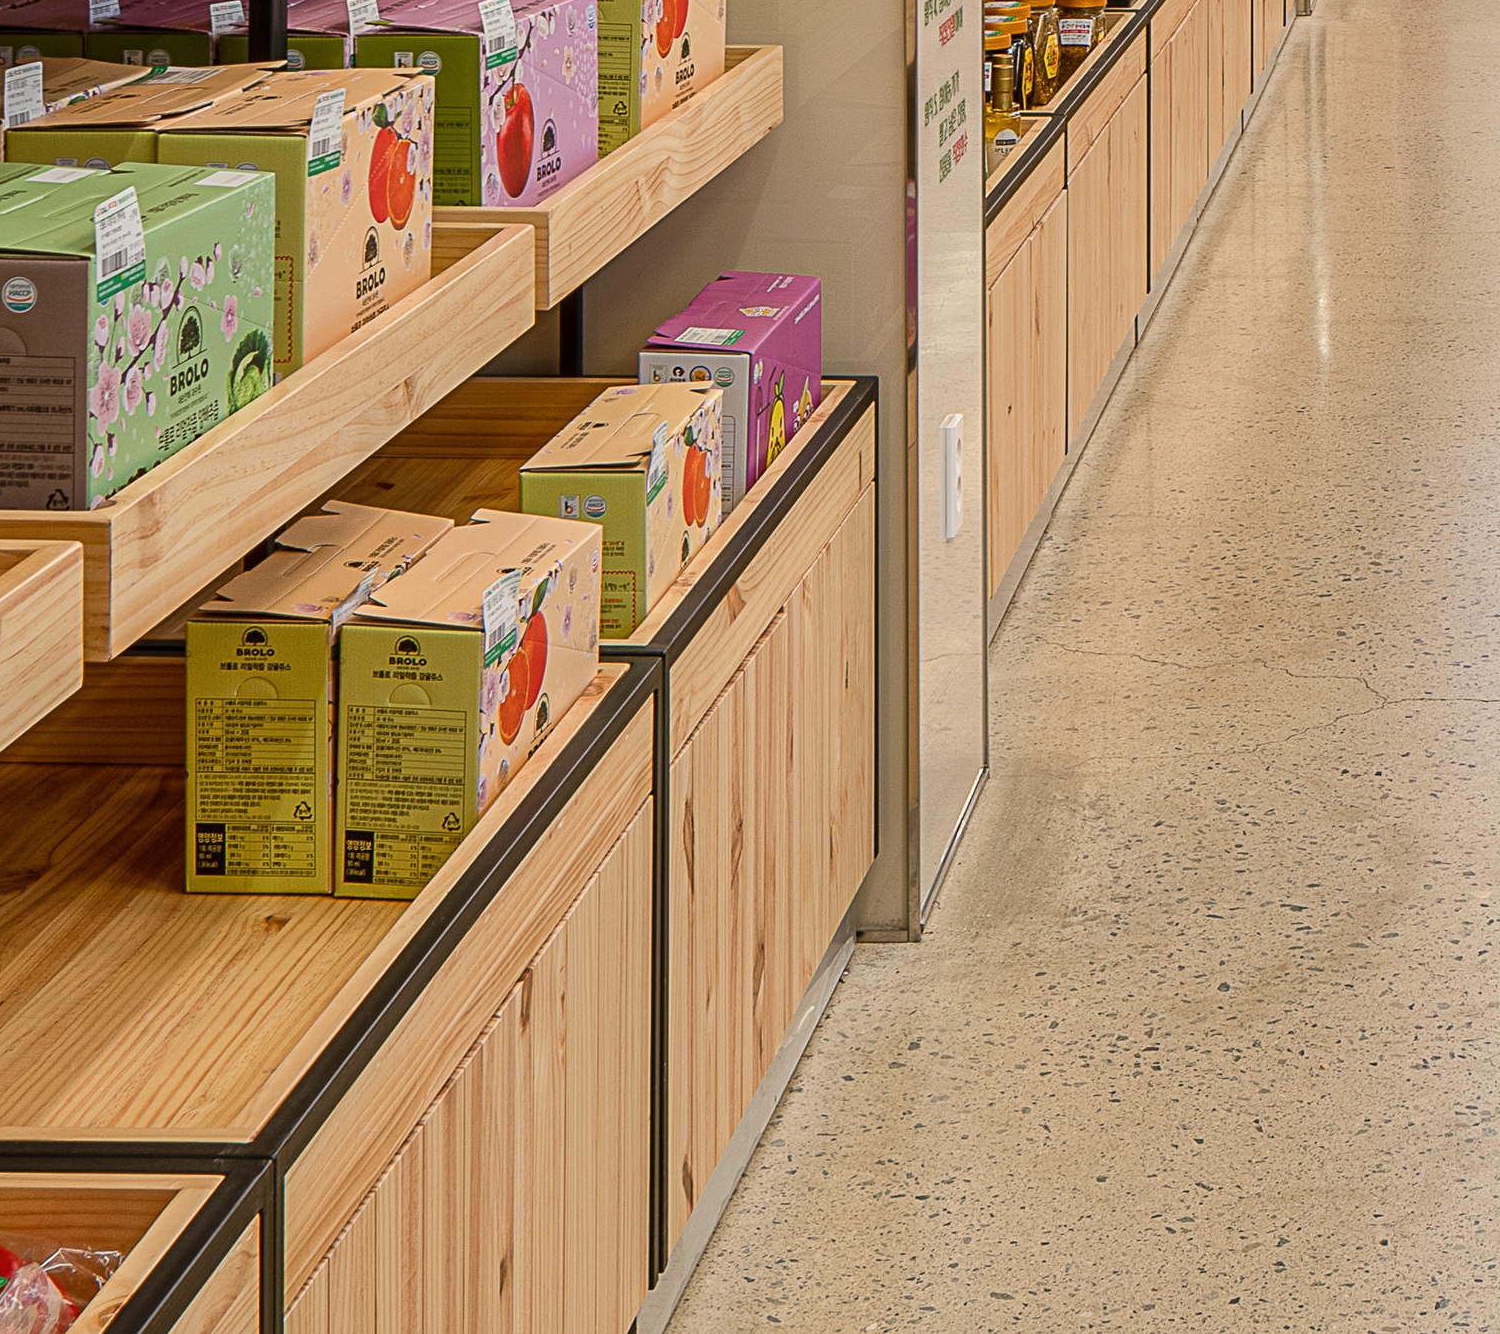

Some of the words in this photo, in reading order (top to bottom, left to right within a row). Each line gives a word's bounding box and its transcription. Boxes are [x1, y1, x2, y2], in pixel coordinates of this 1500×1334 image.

[674, 60, 696, 91] BROLO
[536, 155, 562, 182] BROLO
[355, 267, 386, 299] BROLO
[170, 357, 209, 398] BROLO
[235, 648, 277, 662] BROLO
[387, 656, 428, 670] BROLO
